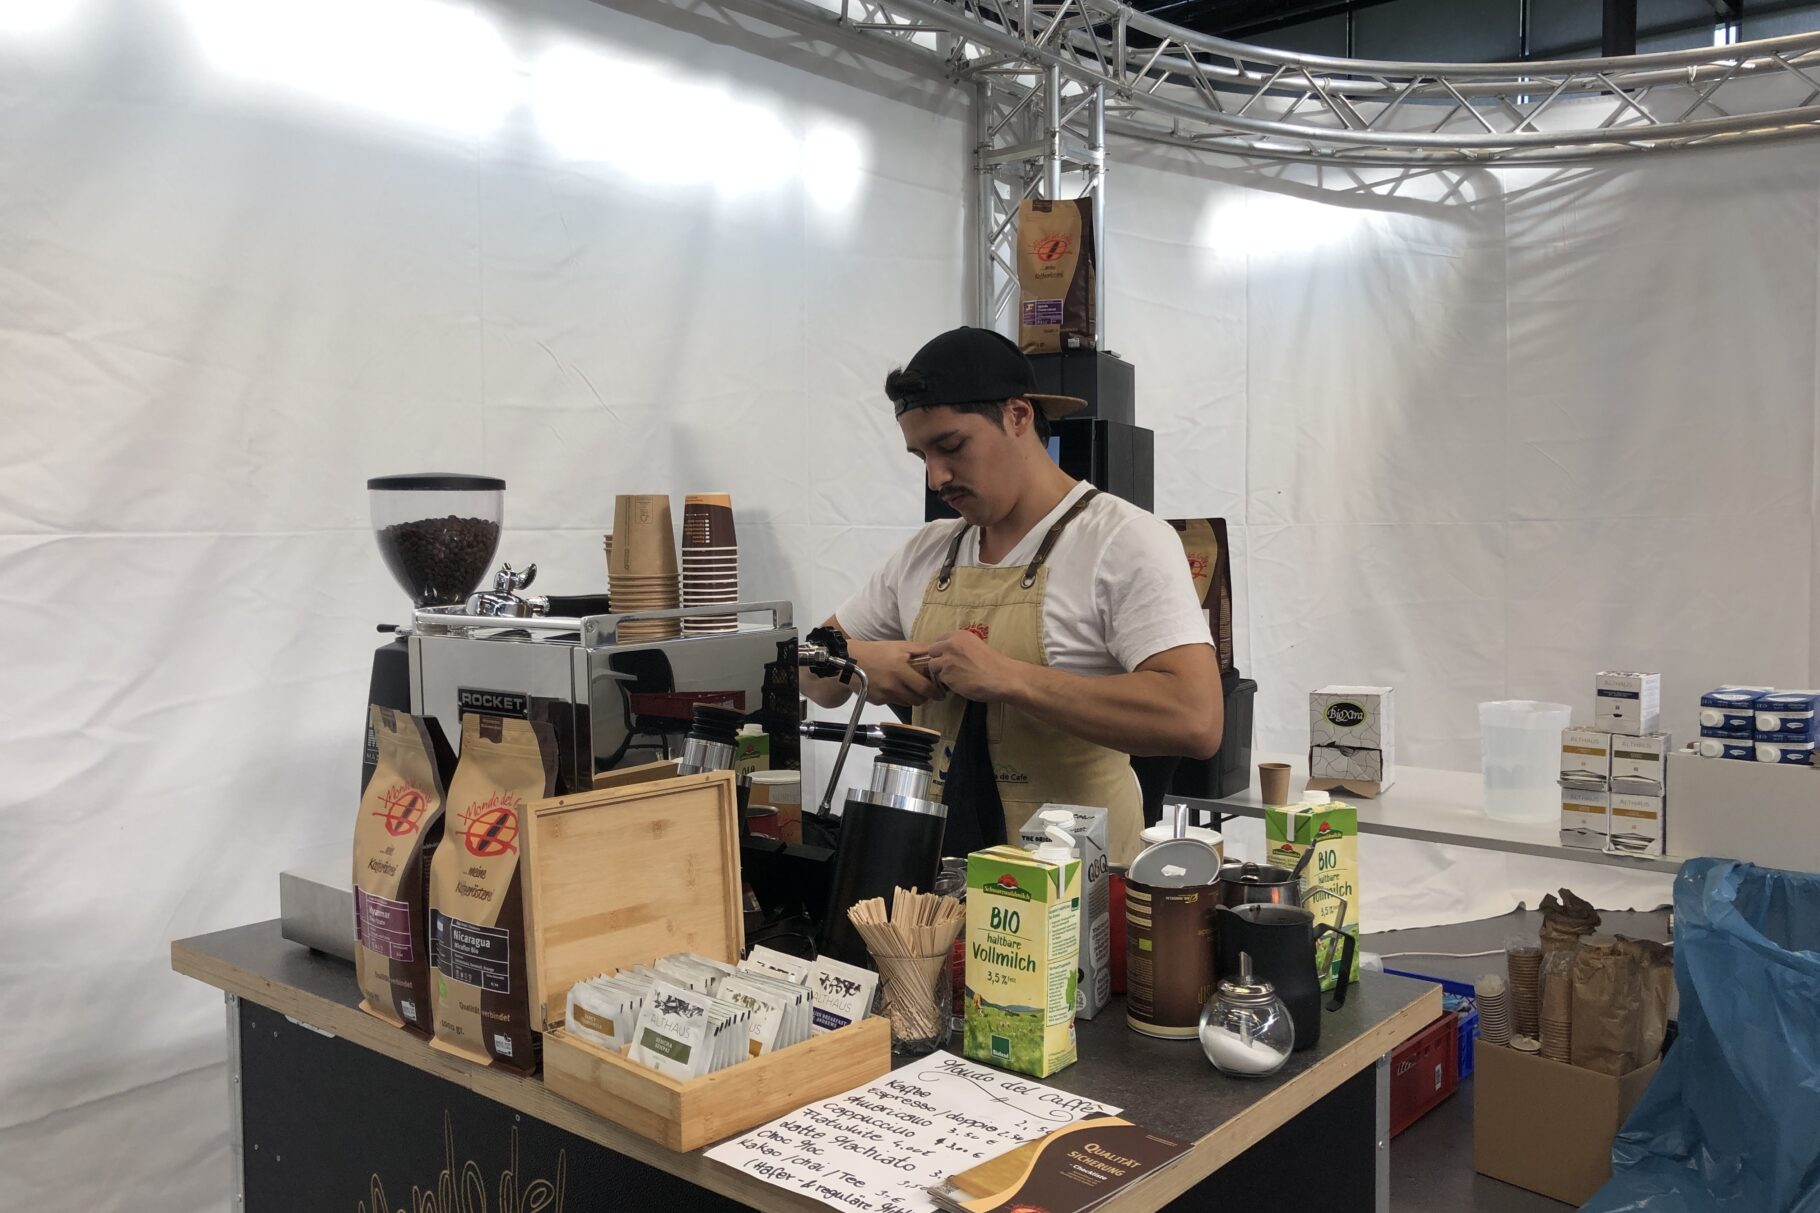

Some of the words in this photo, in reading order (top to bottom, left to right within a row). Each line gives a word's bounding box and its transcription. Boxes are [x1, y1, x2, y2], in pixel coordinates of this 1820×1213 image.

[461, 692, 523, 710] ROCKET
[1318, 849, 1337, 871] BIO
[990, 906, 1021, 934] BIO
[453, 929, 491, 948] Nicaragua
[986, 932, 1022, 950] haltbare
[972, 941, 1036, 973] Vollmilch
[459, 1001, 480, 1015] Qualität
[481, 1011, 511, 1022] verbindet
[650, 1015, 691, 1039] ALTHAUS
[884, 1079, 932, 1098] Kaffee
[935, 1059, 995, 1082] Mondo
[1000, 1082, 1034, 1096] del
[1038, 1092, 1104, 1114] Caffè
[843, 1095, 933, 1127] Americano
[866, 1087, 937, 1113] Espresso
[779, 1121, 826, 1139] Latte
[803, 1108, 886, 1142] Flatwhite
[823, 1103, 916, 1138] Cappuccino
[737, 1138, 782, 1157] Kakao
[757, 1130, 793, 1145] Choc
[1067, 1150, 1127, 1177] SICHERUNG
[1084, 1142, 1142, 1169] QUALITÄT
